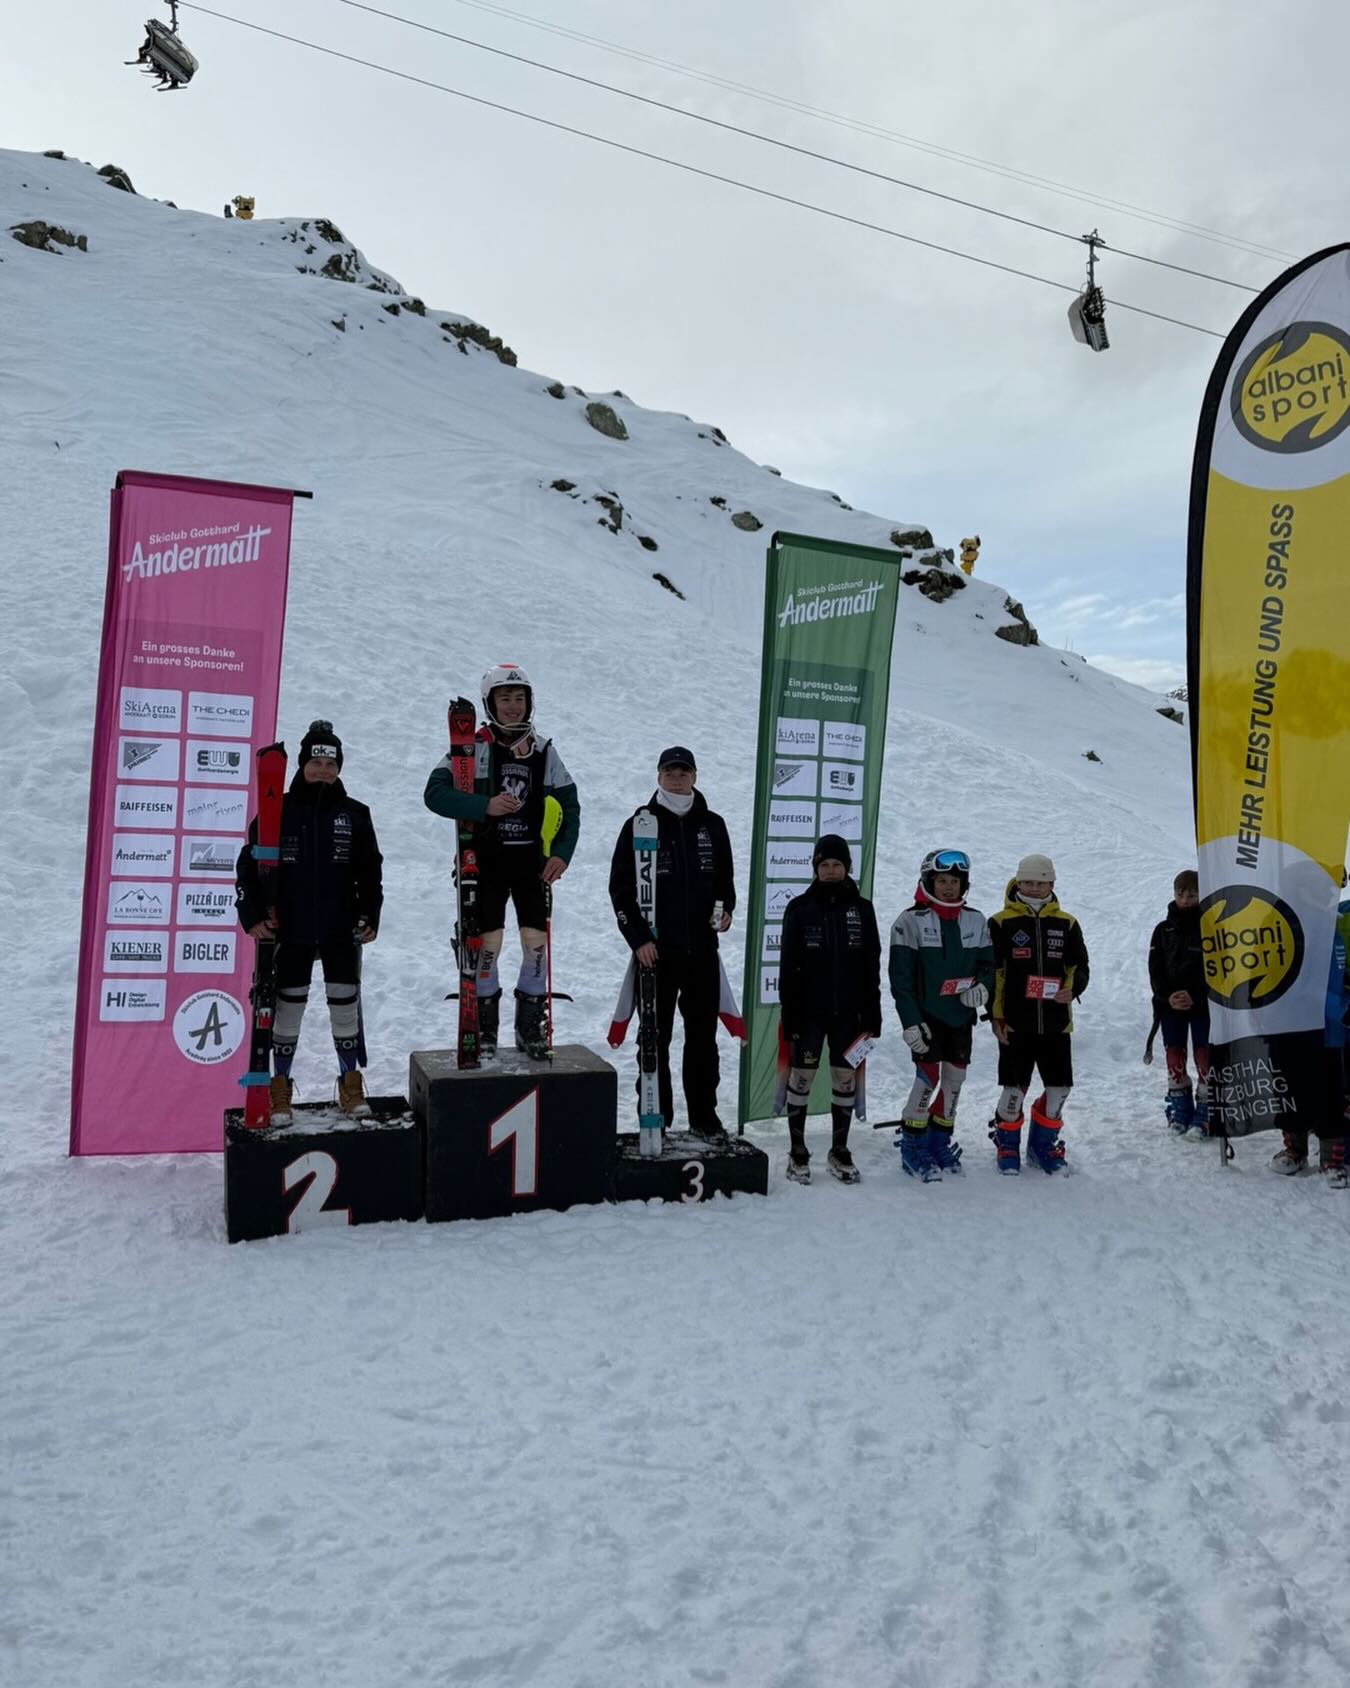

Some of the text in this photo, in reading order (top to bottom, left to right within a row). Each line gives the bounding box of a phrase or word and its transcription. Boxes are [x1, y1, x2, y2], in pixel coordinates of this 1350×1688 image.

[1248, 352, 1344, 398] albani
[1253, 377, 1347, 422] sport
[149, 522, 240, 545] Skiclub Gotthard
[122, 524, 272, 583] Andermatt
[797, 579, 864, 597] Skiclub Gotthard
[778, 580, 885, 629] Andermatt
[142, 641, 235, 659] Ein grosses Danke
[133, 655, 245, 672] an unsere Sponsoren!
[788, 678, 801, 687] Ein
[802, 681, 832, 691] grosses
[1236, 503, 1295, 869] MEHR LEISTUNG UND SPASS
[792, 692, 820, 700] unsere
[124, 701, 177, 714] SkiArena
[192, 705, 250, 717] THE CHEDI
[197, 750, 241, 767] EWU
[120, 802, 173, 813] RAIFFEISEN
[116, 849, 168, 862] Andermatt
[186, 893, 234, 907] PIZZA LOFT
[1201, 920, 1282, 953] albani
[111, 942, 162, 954] KIENER
[183, 943, 229, 961] BIGLER
[1206, 944, 1286, 978] sport
[1207, 1096, 1298, 1124] FTRINGEN
[487, 1085, 539, 1196] 1
[681, 1160, 706, 1202] 3
[283, 1150, 352, 1233] 2
